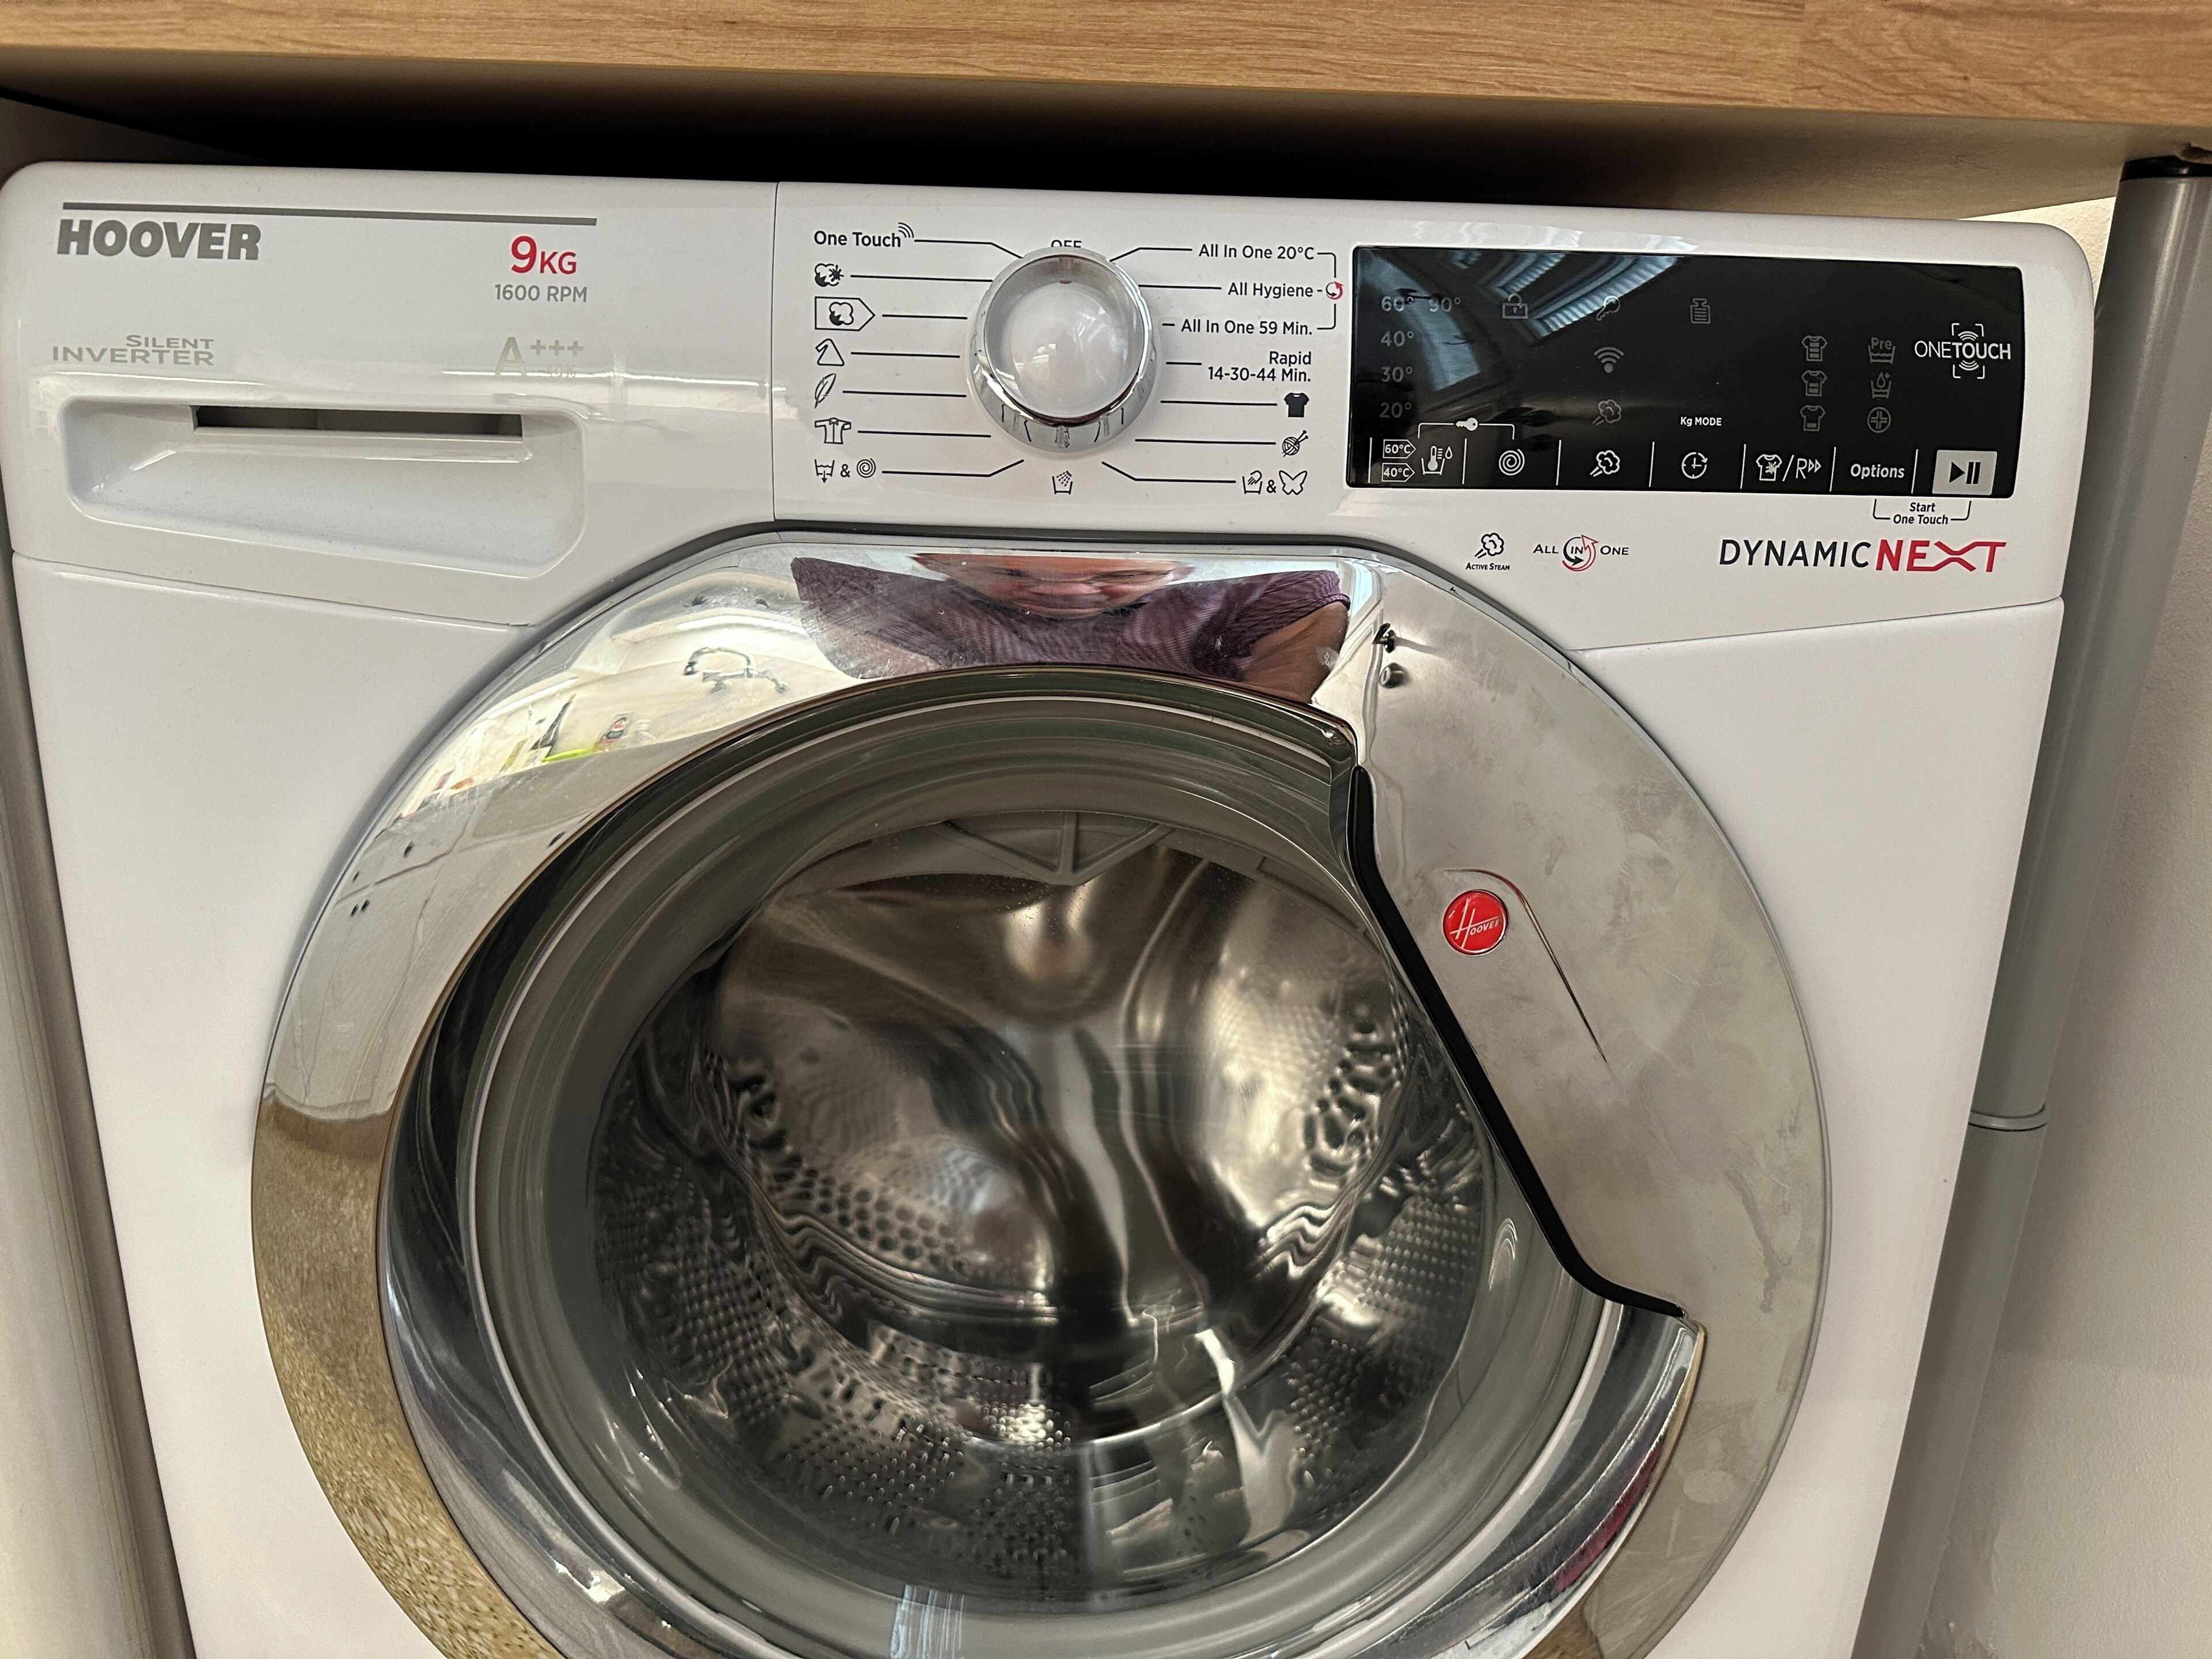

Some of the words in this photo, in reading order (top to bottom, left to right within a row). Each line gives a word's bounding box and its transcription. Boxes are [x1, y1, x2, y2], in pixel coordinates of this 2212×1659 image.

[56, 219, 262, 260] HOOVER
[814, 230, 847, 245] One
[852, 232, 901, 247] Touch
[1199, 244, 1218, 257] All
[1224, 244, 1237, 257] In
[1243, 245, 1272, 259] One
[1277, 247, 1314, 260] 20°C
[495, 284, 540, 301] 1600
[547, 286, 588, 302] RPM
[1228, 282, 1247, 296] All
[1253, 283, 1313, 298] Hygiene
[1381, 296, 1414, 312] 60°
[1181, 319, 1200, 332] All
[1206, 320, 1219, 333] In
[1225, 320, 1254, 334] One
[1259, 321, 1277, 335] 59
[1283, 321, 1312, 335] Min.
[126, 335, 214, 349] SILENT
[1381, 330, 1414, 346] 40°
[1870, 337, 1893, 350] Pre
[52, 346, 214, 366] INVERTER
[1269, 351, 1312, 367] Rapid
[1208, 366, 1277, 381] 14-30-44
[1281, 368, 1311, 382] Min.
[1381, 366, 1413, 382] 30°
[1379, 402, 1411, 418] 20°
[1680, 416, 1692, 427] Kg
[1695, 417, 1722, 426] MODE
[1385, 444, 1411, 454] 60°C
[1383, 467, 1410, 478] 40°C
[1850, 463, 1905, 479] Options
[1909, 502, 1936, 512] Start
[1893, 514, 1914, 524] One
[1918, 514, 1948, 525] Touch
[1570, 546, 1584, 555] IN
